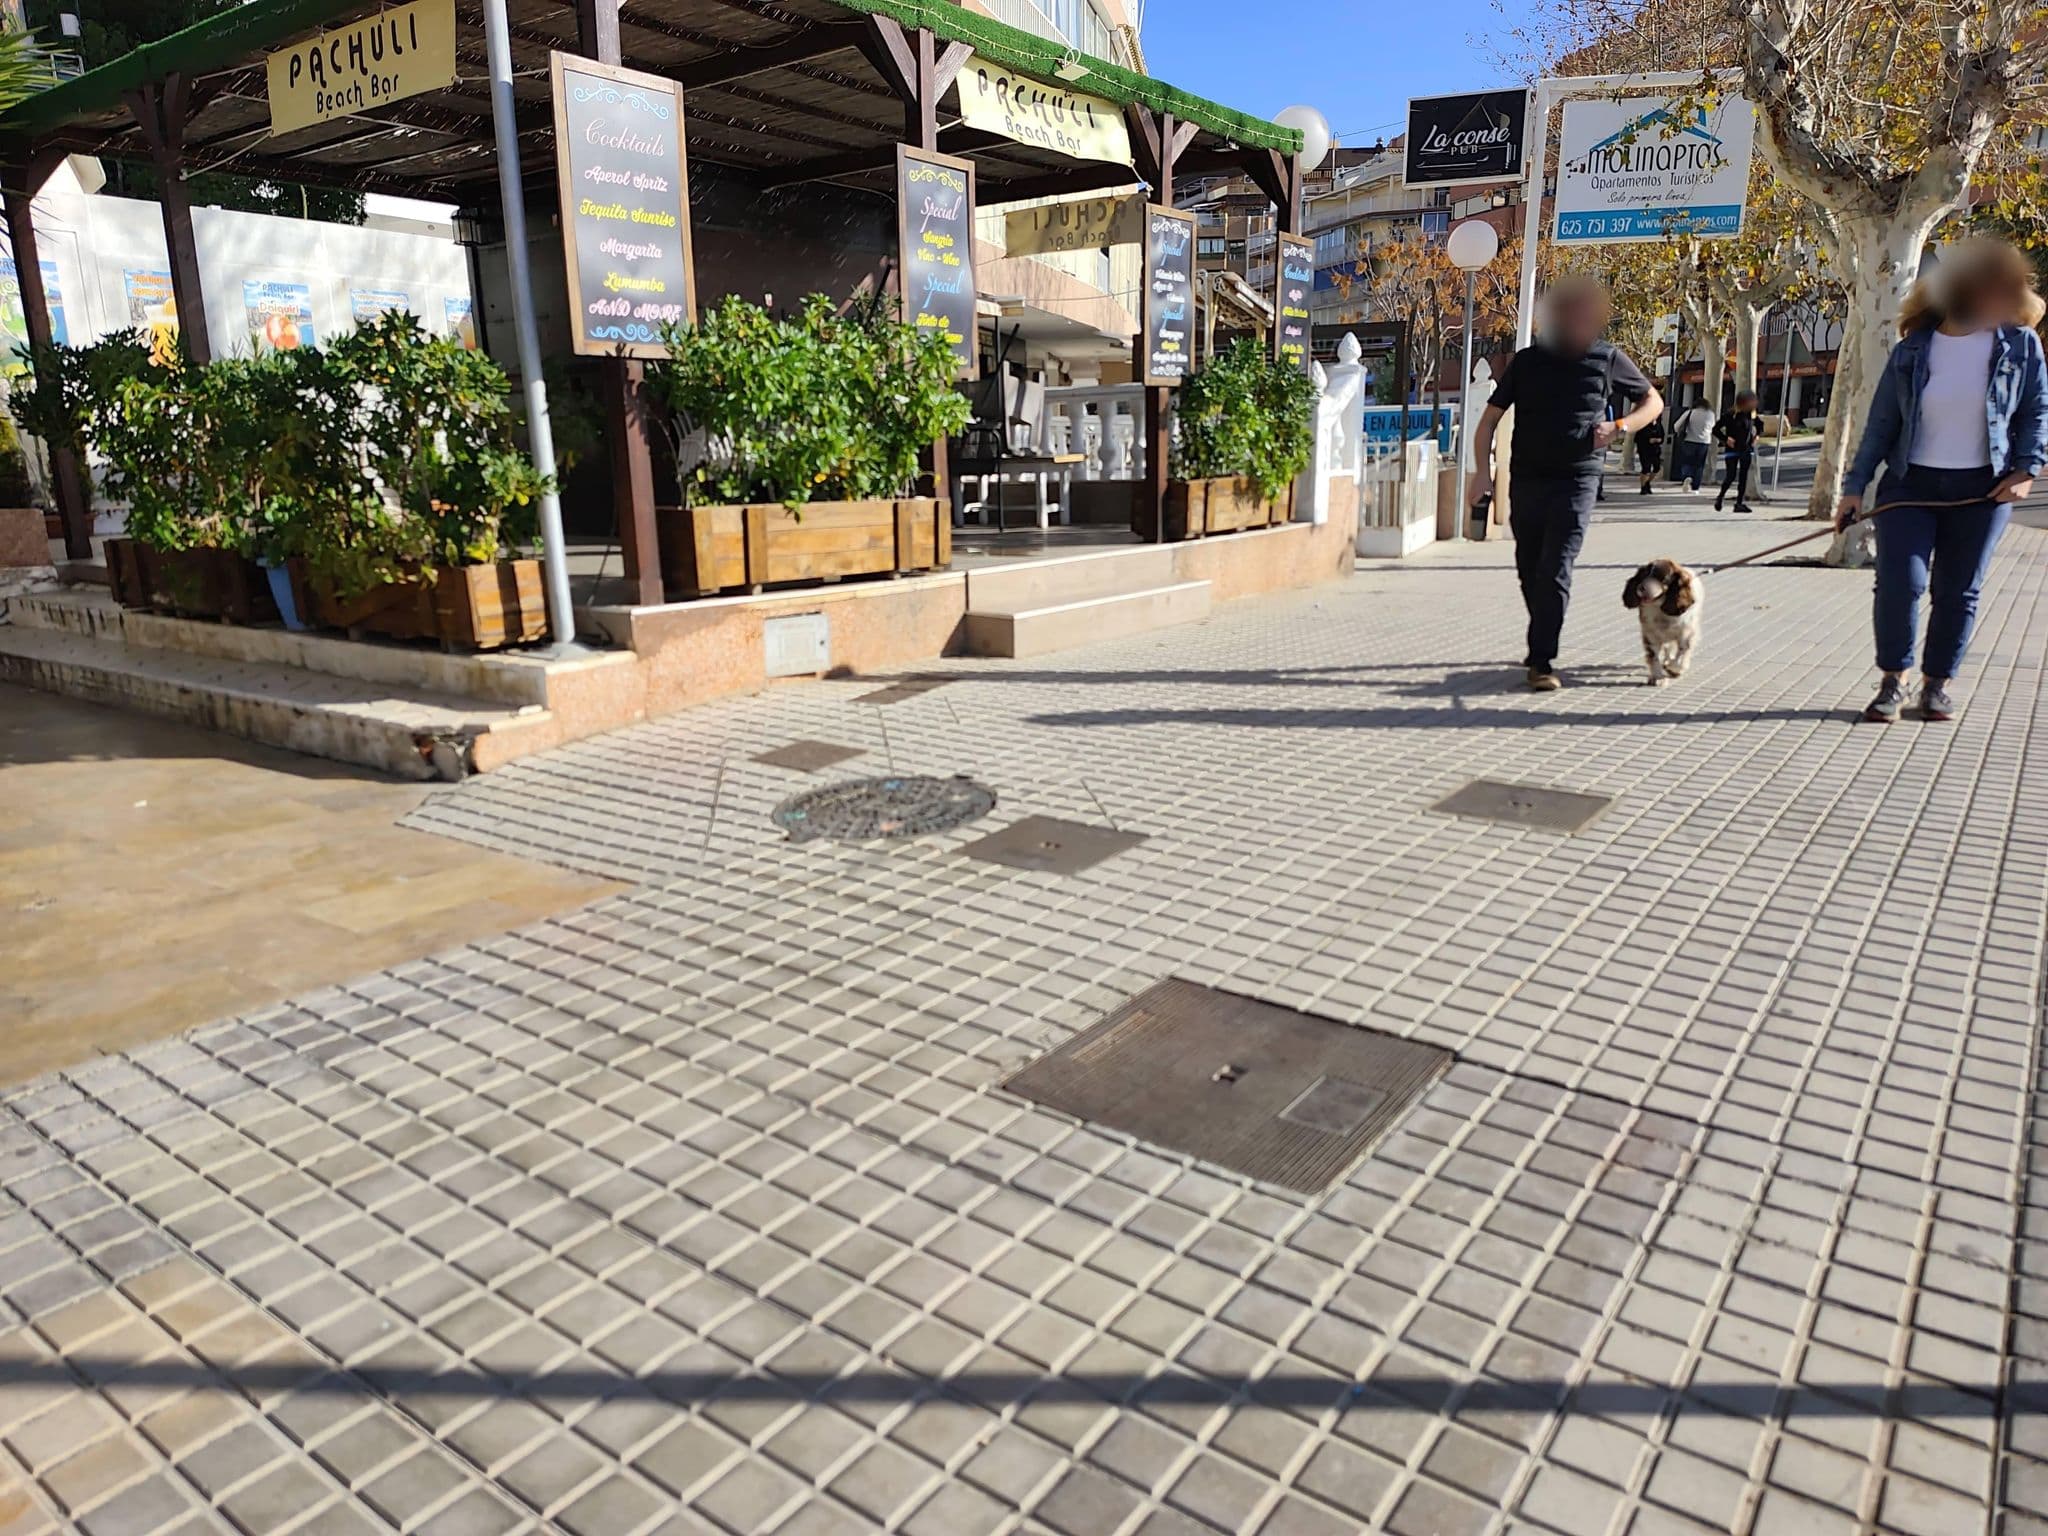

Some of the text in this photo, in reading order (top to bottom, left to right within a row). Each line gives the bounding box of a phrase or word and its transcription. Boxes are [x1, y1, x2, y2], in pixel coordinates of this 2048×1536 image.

[289, 12, 418, 89] PACHULI
[316, 74, 399, 118] Beach Bar
[977, 68, 1095, 128] PACHULI
[585, 119, 665, 157] Cocktails
[1005, 115, 1082, 153] Beach Bar
[1420, 124, 1511, 152] La conse
[1450, 145, 1478, 156] PUB
[584, 166, 669, 193] Aperol Spritz
[580, 199, 676, 228] Tequila Sunrise
[920, 195, 963, 234] Special
[1561, 218, 1582, 235] 625
[1588, 218, 1606, 234] 751
[1610, 217, 1632, 233] 397
[600, 238, 662, 261] Margarita
[603, 271, 665, 293] Lumumba
[922, 269, 966, 309] Special
[588, 297, 630, 318] AND
[1370, 415, 1385, 432] EN
[1389, 413, 1446, 431] ALUILR
